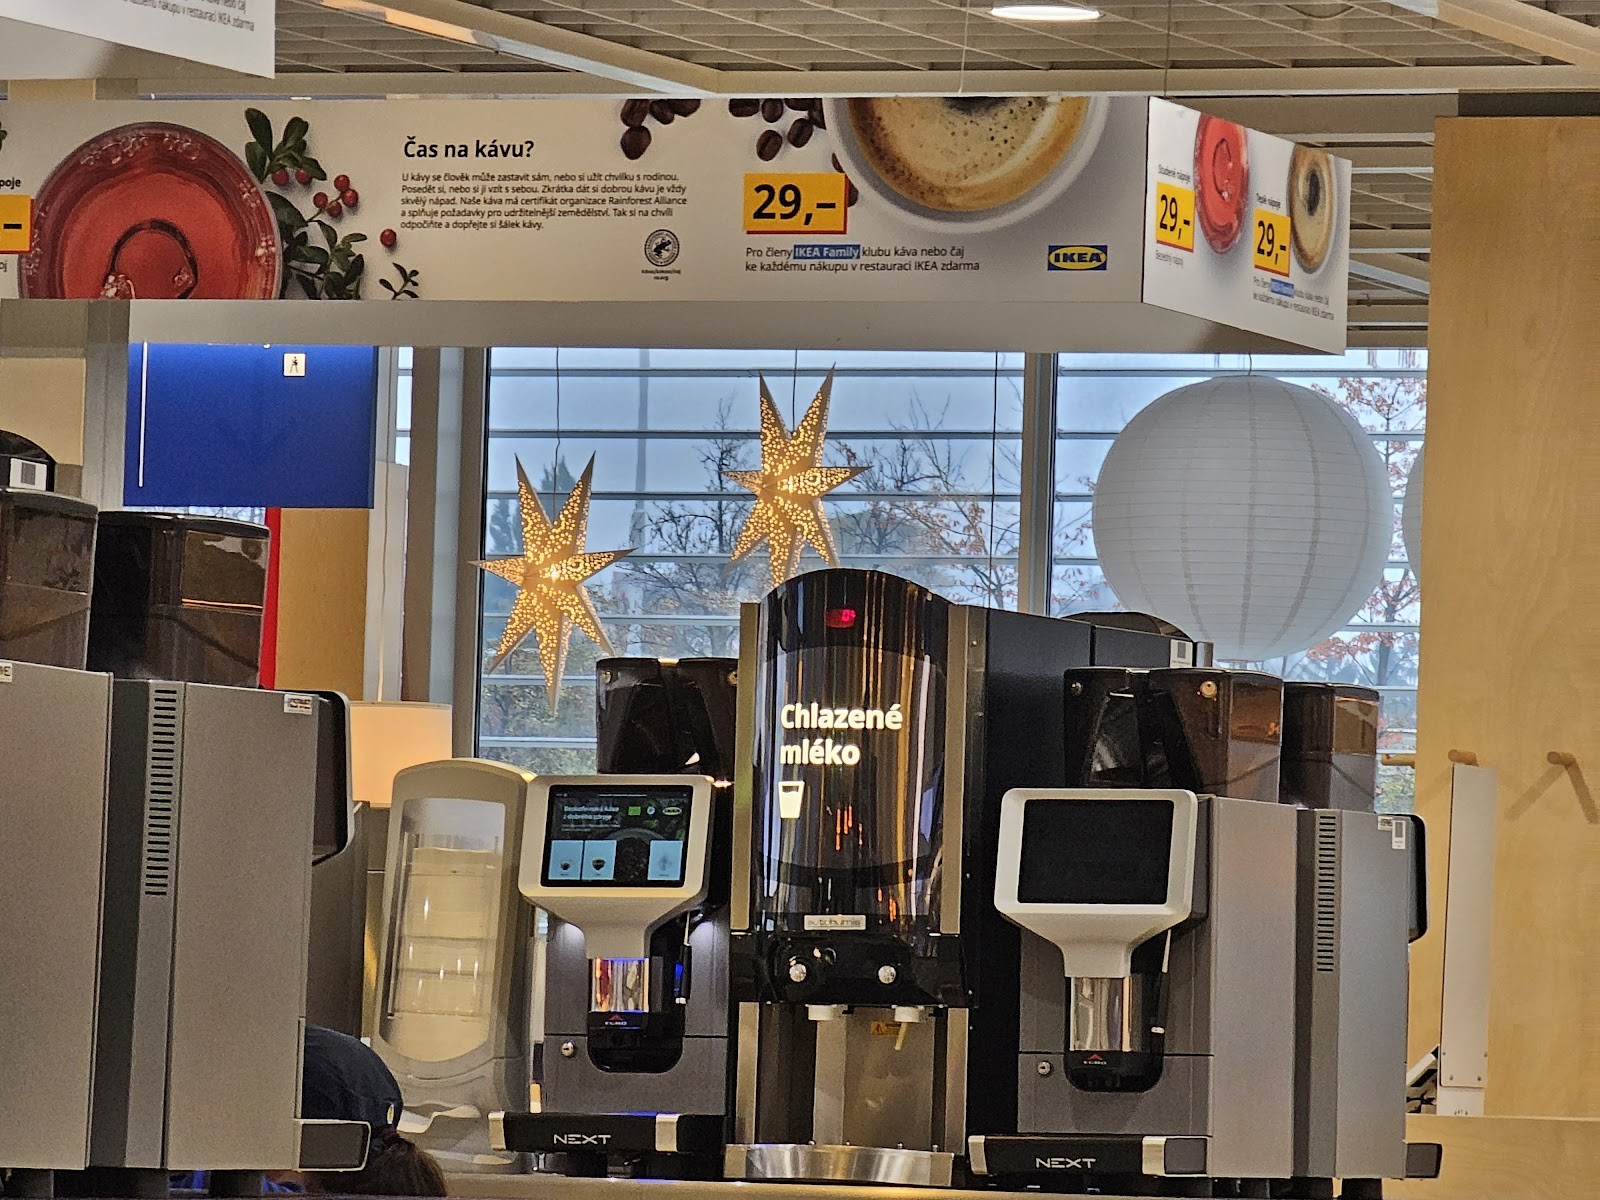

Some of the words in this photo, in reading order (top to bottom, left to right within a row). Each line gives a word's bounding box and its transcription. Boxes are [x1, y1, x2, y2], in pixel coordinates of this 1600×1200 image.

[404, 135, 438, 158] Čas
[445, 144, 468, 158] na
[475, 139, 535, 158] kávu?
[402, 173, 409, 182] U
[410, 173, 430, 184] kávy
[432, 174, 442, 182] se
[444, 172, 470, 182] člověk
[472, 172, 496, 182] může
[498, 173, 530, 182] zastavit
[532, 172, 552, 183] sám,
[554, 173, 576, 182] nebo
[578, 173, 586, 182] si
[636, 174, 641, 182] s
[643, 172, 679, 182] rodinou.
[402, 185, 436, 194] Posedět
[438, 185, 446, 195] si,
[449, 185, 471, 194] nebo
[473, 185, 480, 194] si
[505, 186, 510, 194] s
[512, 185, 539, 194] sebou.
[542, 184, 574, 194] Zkrátka
[576, 184, 590, 194] dát
[592, 184, 599, 194] si
[601, 184, 632, 194] dobrou
[634, 184, 655, 194] kávu
[656, 185, 664, 196] je
[666, 184, 687, 195] vždy
[401, 196, 426, 207] skvělý
[429, 196, 458, 207] nápad.
[460, 196, 481, 205] Naše
[484, 196, 503, 205] káva
[505, 196, 518, 205] má
[520, 196, 558, 205] certifikát
[560, 196, 606, 207] organizace
[608, 196, 652, 205] Rainforest
[654, 196, 687, 205] Alliance
[408, 208, 438, 219] splňuje
[440, 208, 486, 219] požadavky
[488, 210, 502, 219] pro
[504, 208, 556, 219] udržitelnější
[558, 208, 610, 217] zemědělství.
[612, 208, 628, 217] Tak
[629, 208, 636, 217] si
[400, 220, 443, 231] odpočiňte
[452, 220, 488, 231] dopřejte
[490, 220, 496, 229] si
[498, 220, 520, 229] šálek
[522, 220, 544, 231] kávy.
[746, 247, 763, 257] Pro
[766, 247, 792, 260] členy
[795, 247, 820, 257] IKEA
[823, 247, 859, 260] Family
[862, 246, 891, 257] klubu
[894, 246, 918, 256] káva
[920, 246, 948, 256] nebo
[950, 246, 965, 259] čaj
[1054, 252, 1102, 262] IKEA
[746, 262, 757, 272] ke
[760, 261, 806, 272] každému
[810, 261, 848, 274] nákupu
[852, 263, 858, 271] v
[860, 261, 912, 272] restauraci
[914, 261, 938, 271] IKEA
[940, 260, 980, 271] zdarma
[780, 702, 904, 730] Chlazené
[780, 738, 860, 766] mléko
[554, 1134, 612, 1145] NEXT
[1036, 1158, 1096, 1169] NEXT
